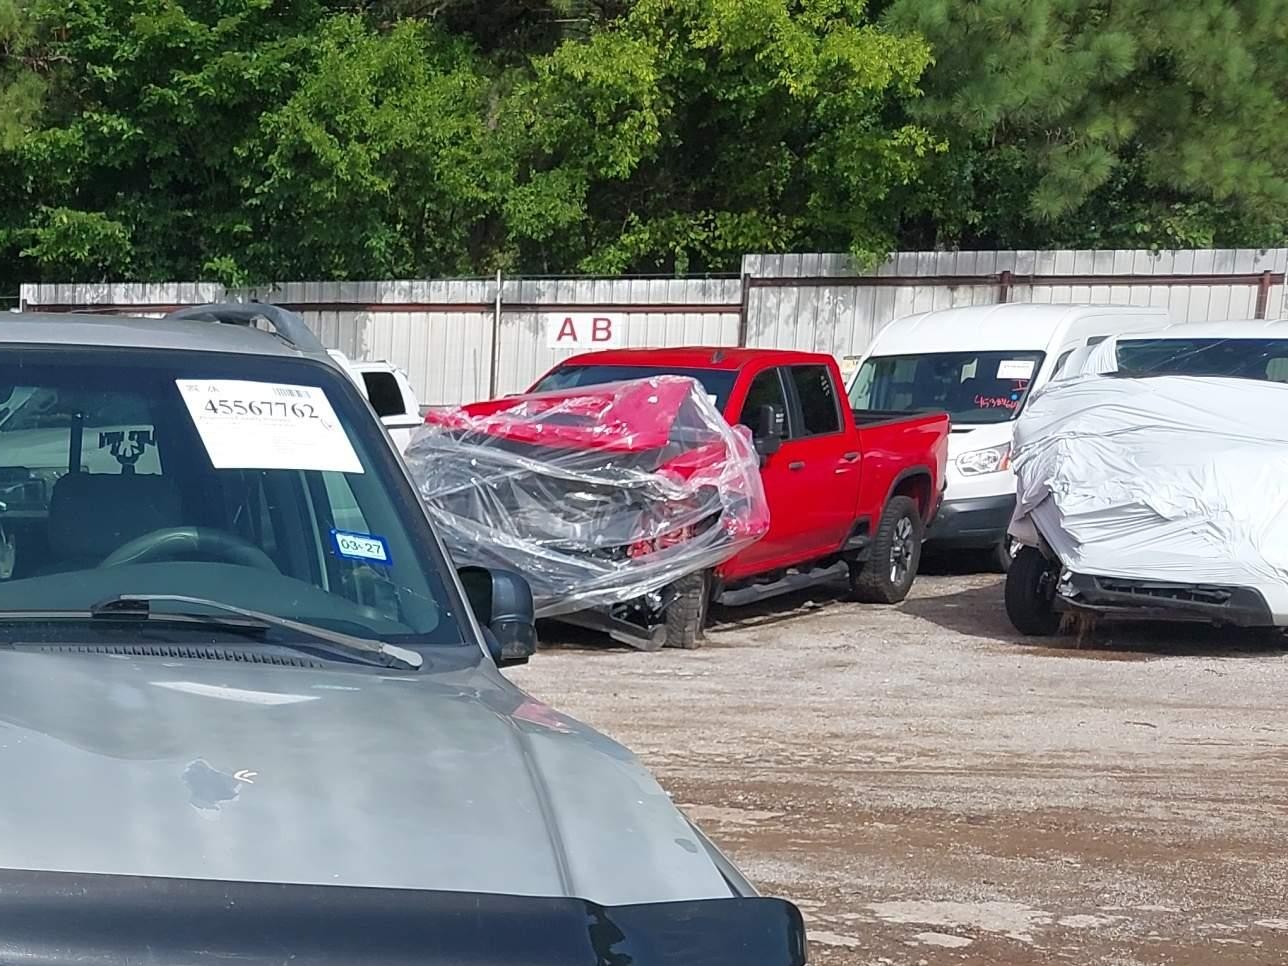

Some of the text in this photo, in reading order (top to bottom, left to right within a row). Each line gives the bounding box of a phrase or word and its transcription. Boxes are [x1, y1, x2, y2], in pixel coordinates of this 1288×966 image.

[556, 317, 612, 342] A B
[204, 399, 319, 419] 45567762
